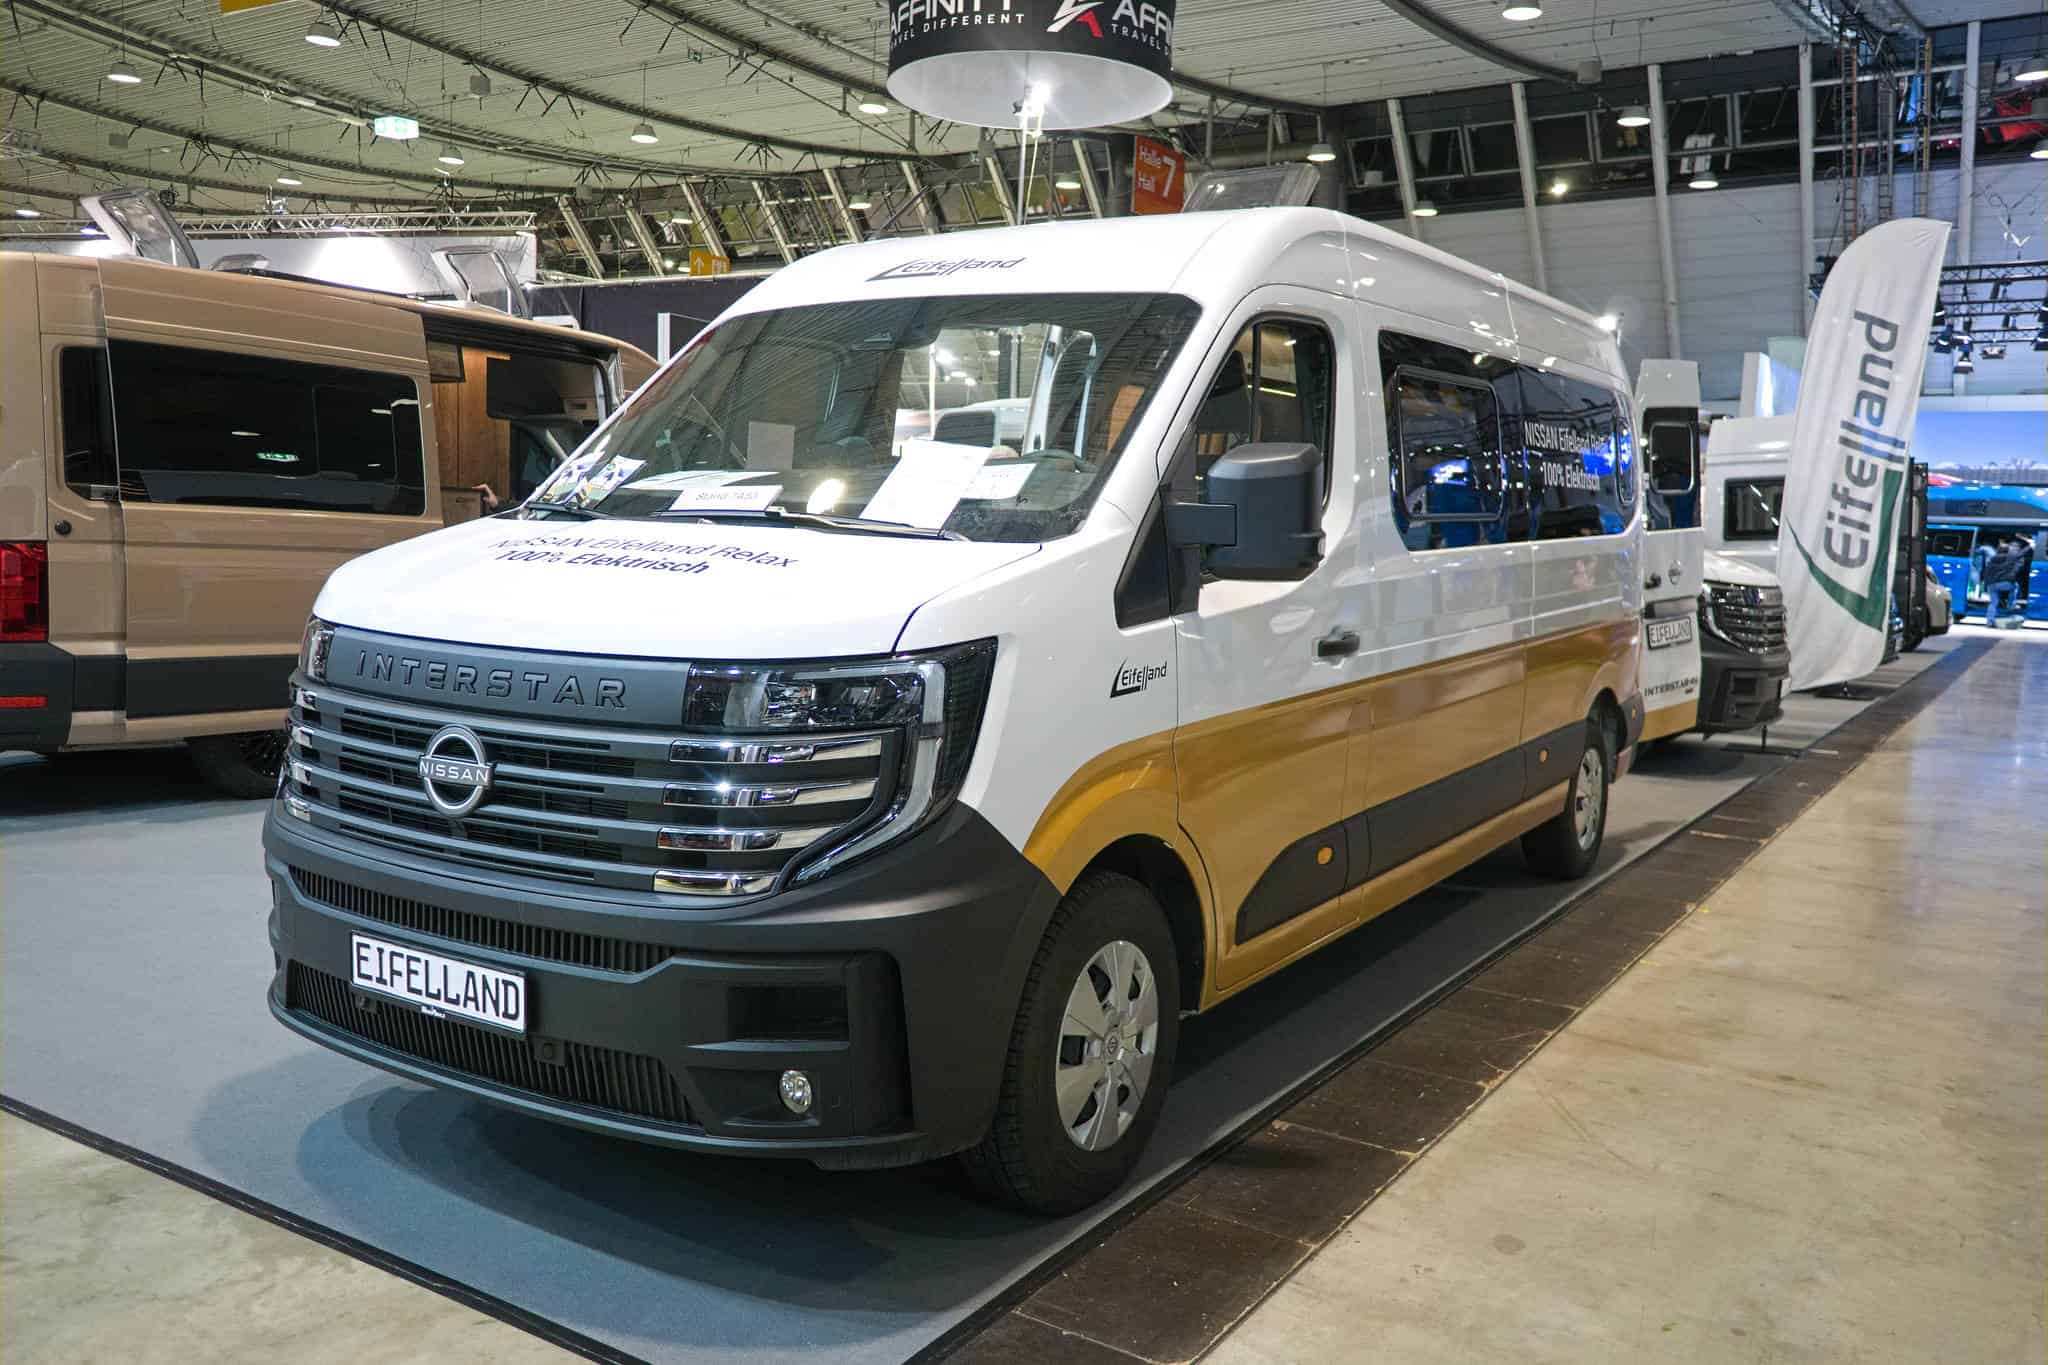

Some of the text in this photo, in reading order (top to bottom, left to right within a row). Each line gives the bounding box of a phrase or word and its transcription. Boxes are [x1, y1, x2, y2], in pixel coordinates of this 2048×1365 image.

[923, 13, 1025, 33] DIFFERENT
[1111, 23, 1161, 50] TRAVEL
[1162, 155, 1177, 198] 7
[901, 257, 1027, 276] Eifelland
[1524, 421, 1558, 450] NISSAN
[1823, 310, 1906, 569] Eifelland
[1542, 462, 1565, 487] 100%
[495, 550, 710, 574] 100% Elektrisch
[594, 538, 715, 555] Eifelland
[709, 545, 799, 568] Relax
[355, 650, 627, 709] INTERSTAR
[1121, 661, 1168, 691] Eifelland
[419, 760, 490, 785] NISSAN
[355, 941, 520, 1021] EIFELLAND
